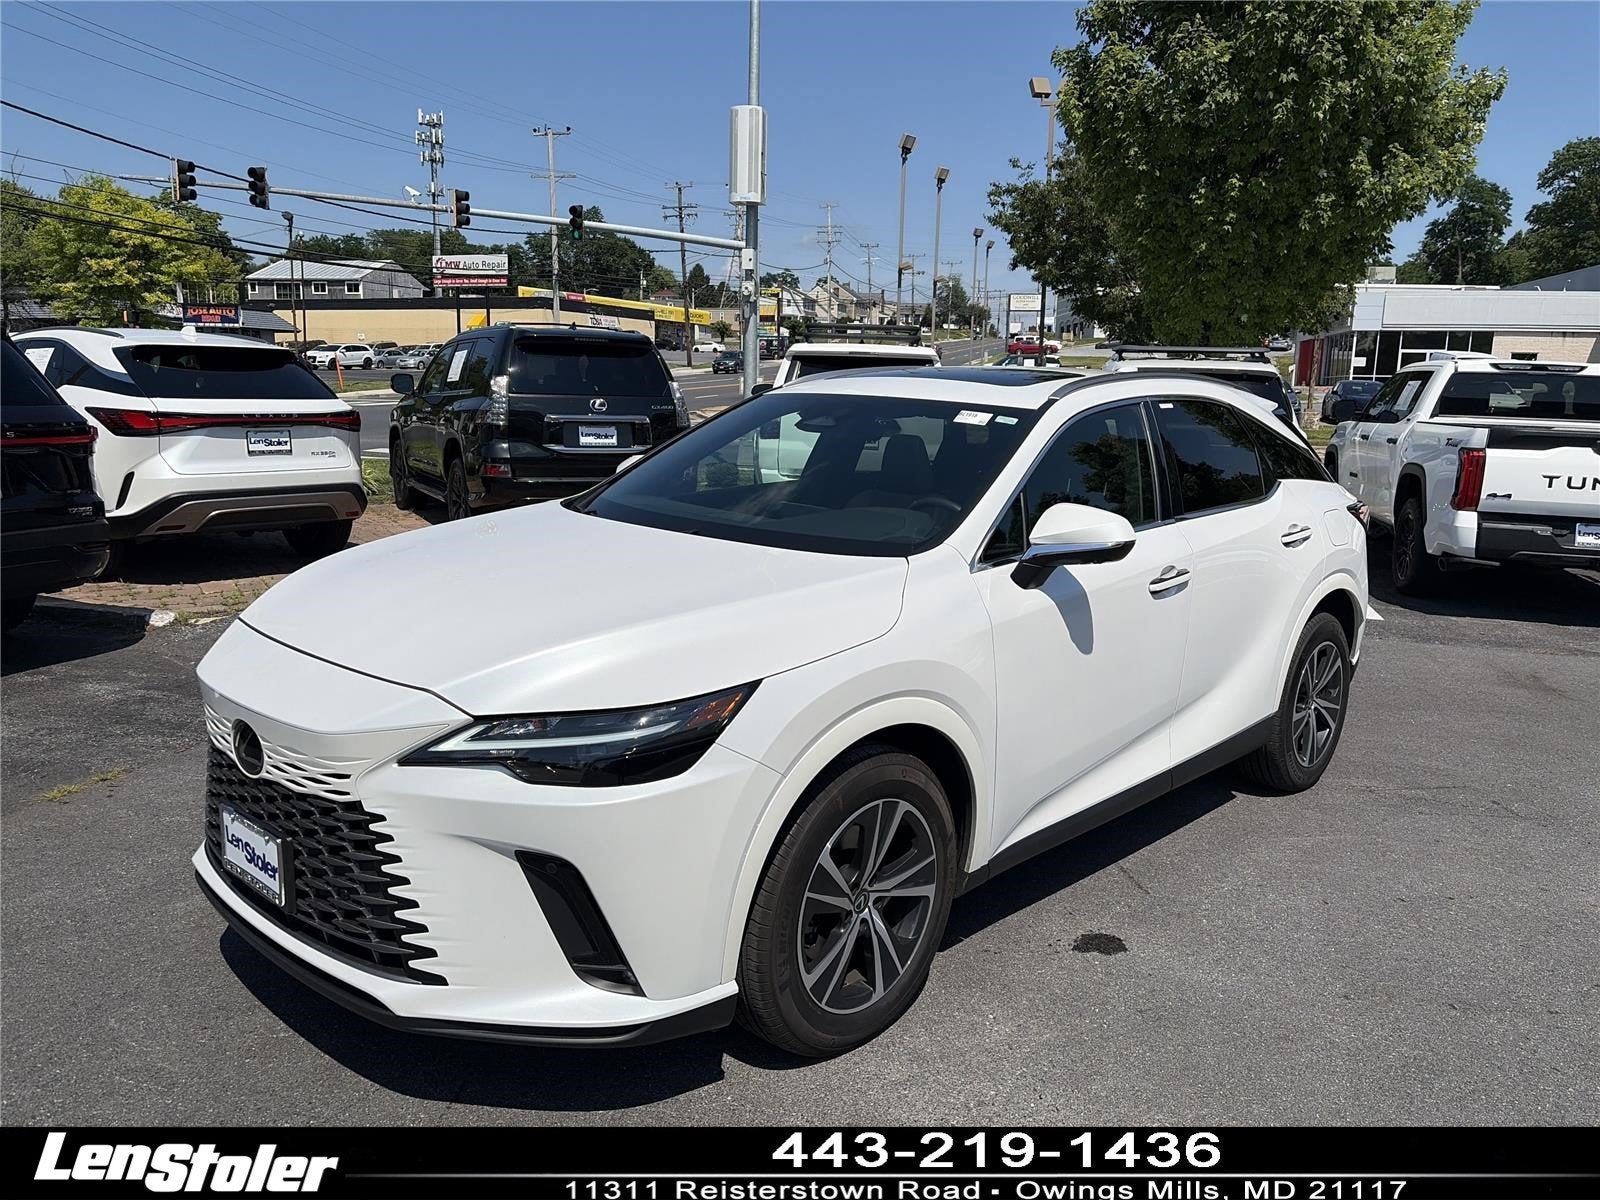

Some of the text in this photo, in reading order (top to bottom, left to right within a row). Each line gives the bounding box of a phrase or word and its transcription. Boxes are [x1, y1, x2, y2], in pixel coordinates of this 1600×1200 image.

[463, 260, 480, 270] Auto
[482, 259, 506, 270] Repair
[187, 306, 236, 319] JOSE AUTO
[581, 431, 616, 440] LenStoler
[249, 437, 289, 447] LenStoler
[225, 824, 278, 882] LenStoler
